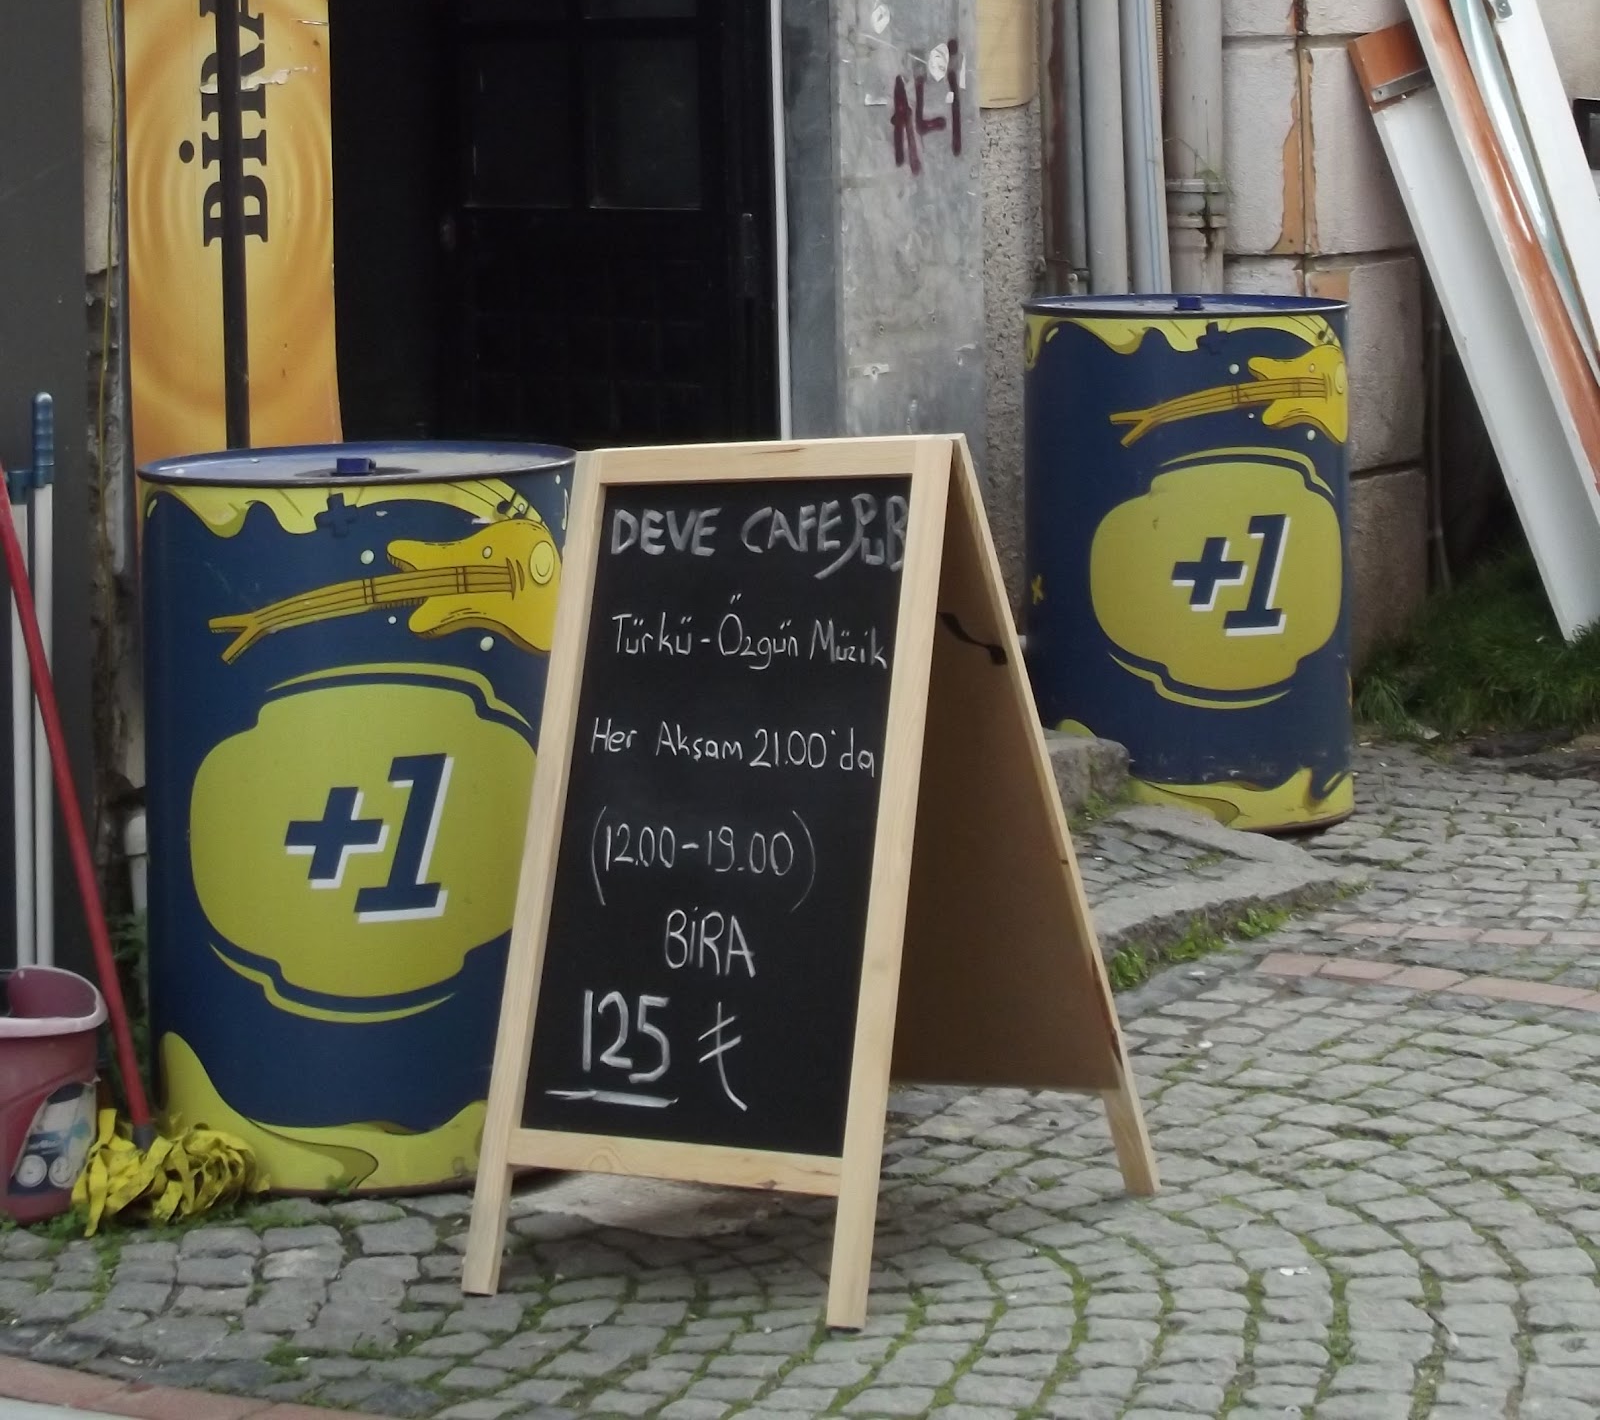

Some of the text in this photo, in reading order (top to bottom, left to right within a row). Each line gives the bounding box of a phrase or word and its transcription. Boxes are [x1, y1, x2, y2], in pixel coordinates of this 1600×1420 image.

[611, 508, 722, 557] DEVE
[740, 500, 842, 554] CAFE
[1171, 514, 1290, 637] +1
[809, 619, 888, 670] Müzik
[590, 717, 637, 754] Her
[284, 753, 455, 923] +1
[582, 990, 672, 1084] 125
